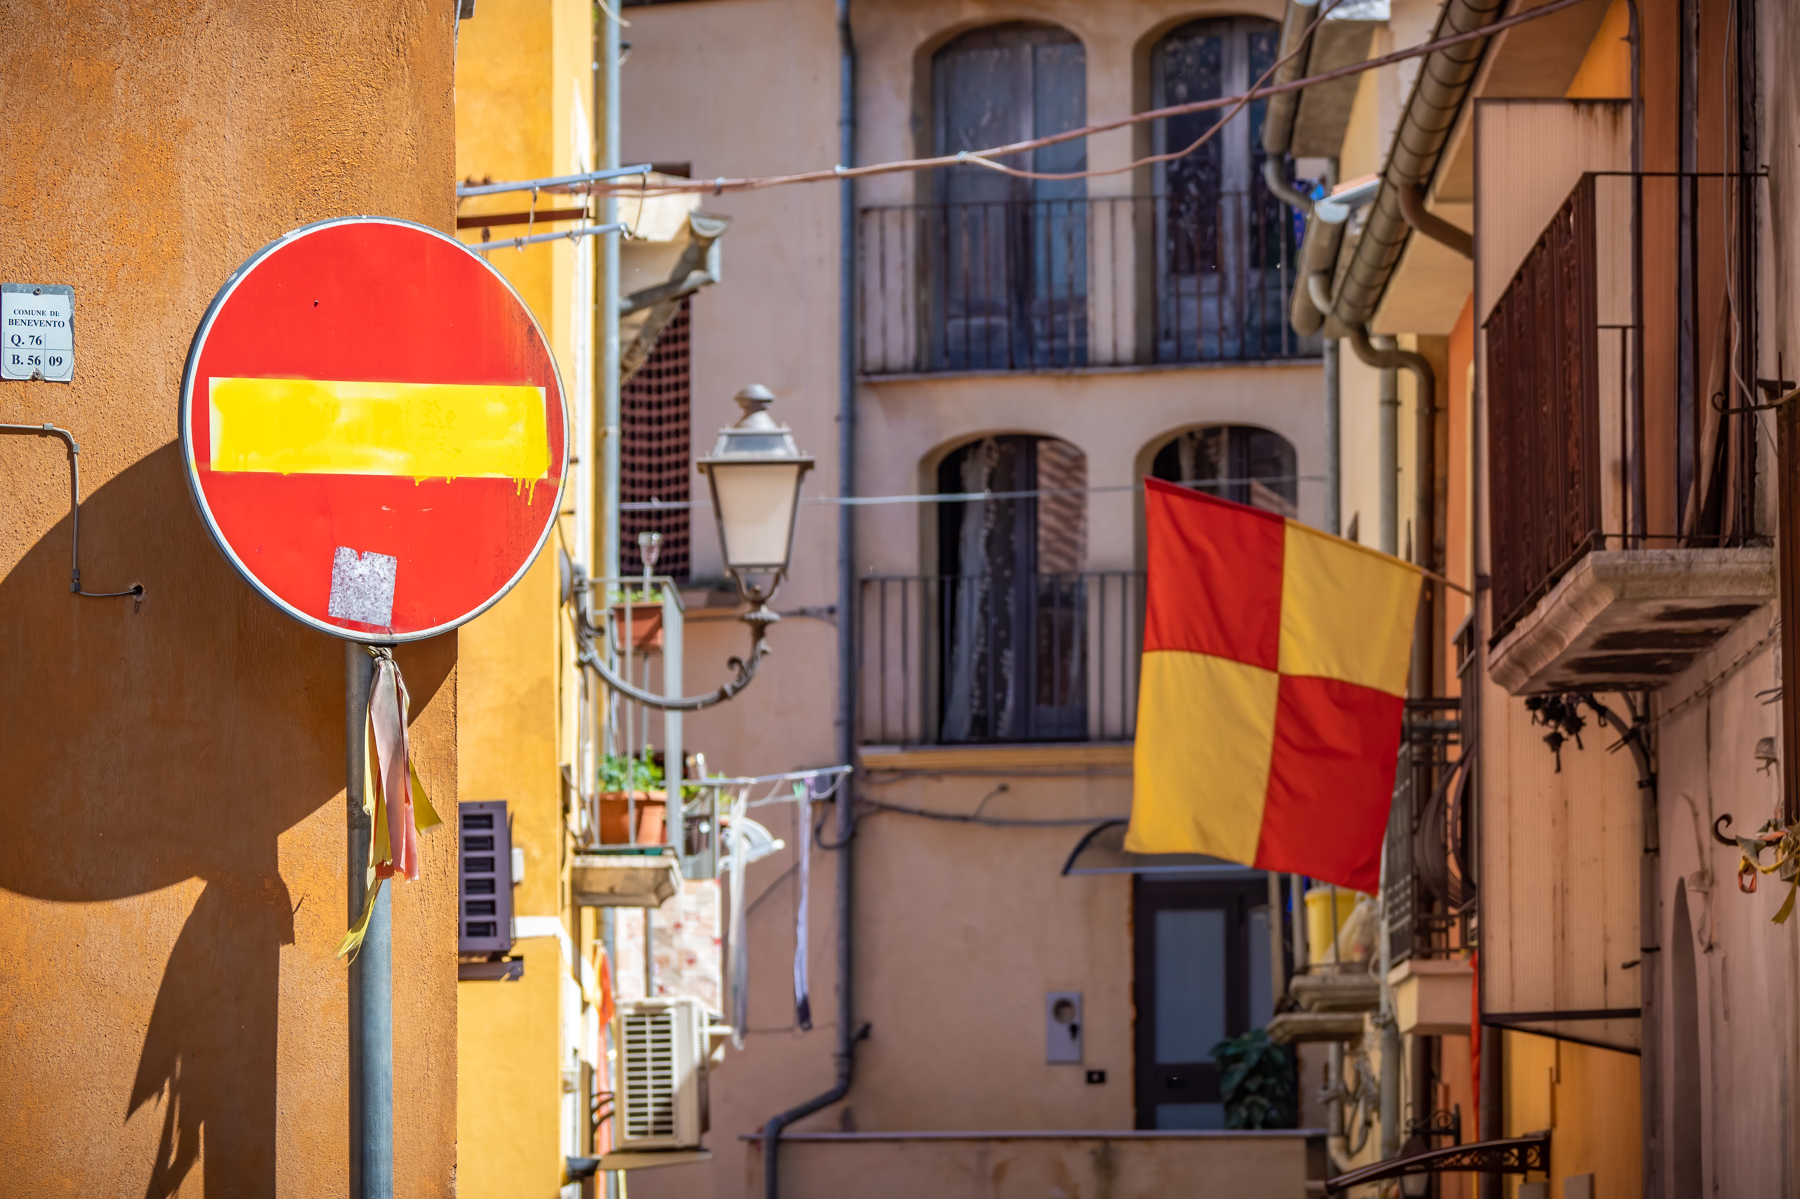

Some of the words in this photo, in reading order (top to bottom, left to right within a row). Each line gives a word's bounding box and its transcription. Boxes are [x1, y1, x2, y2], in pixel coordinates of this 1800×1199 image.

[13, 308, 47, 316] COMUNE
[8, 318, 65, 328] BENEVENTO
[10, 333, 25, 347] Q.
[28, 335, 43, 346] 76
[11, 354, 24, 365] B.
[27, 355, 42, 366] 56
[48, 355, 63, 367] 09
